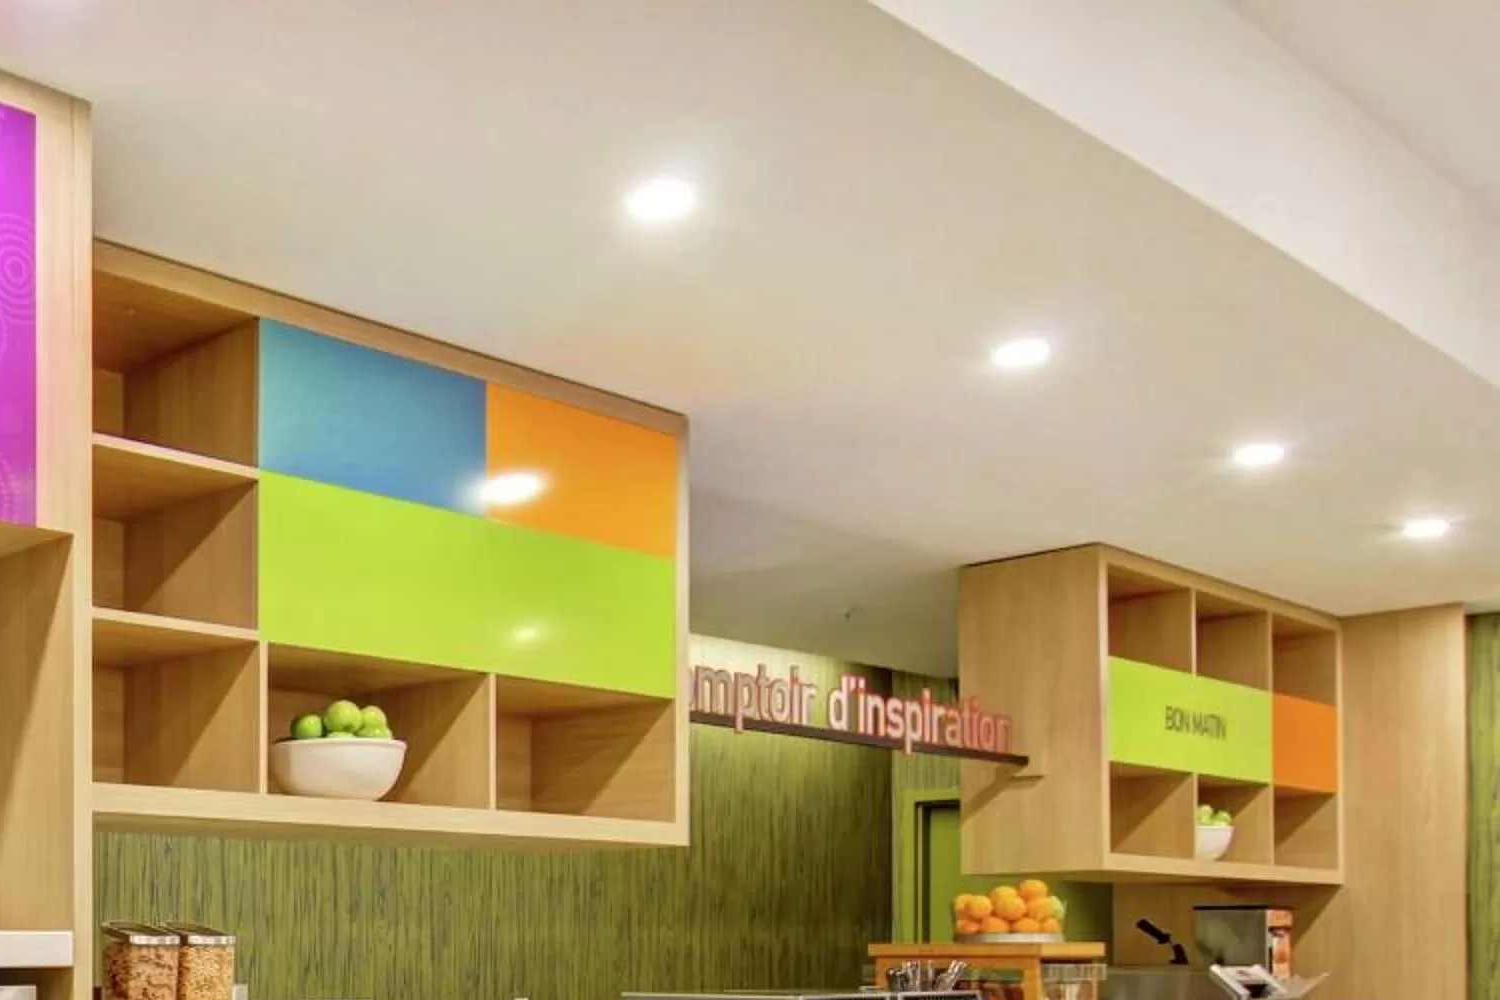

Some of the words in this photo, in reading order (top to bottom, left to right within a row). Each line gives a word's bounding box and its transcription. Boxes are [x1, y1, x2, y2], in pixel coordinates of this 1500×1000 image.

[690, 664, 817, 735] mptoir
[828, 673, 1014, 754] d'inspiration
[1165, 705, 1191, 733] BON
[1192, 710, 1227, 740] MATIN
